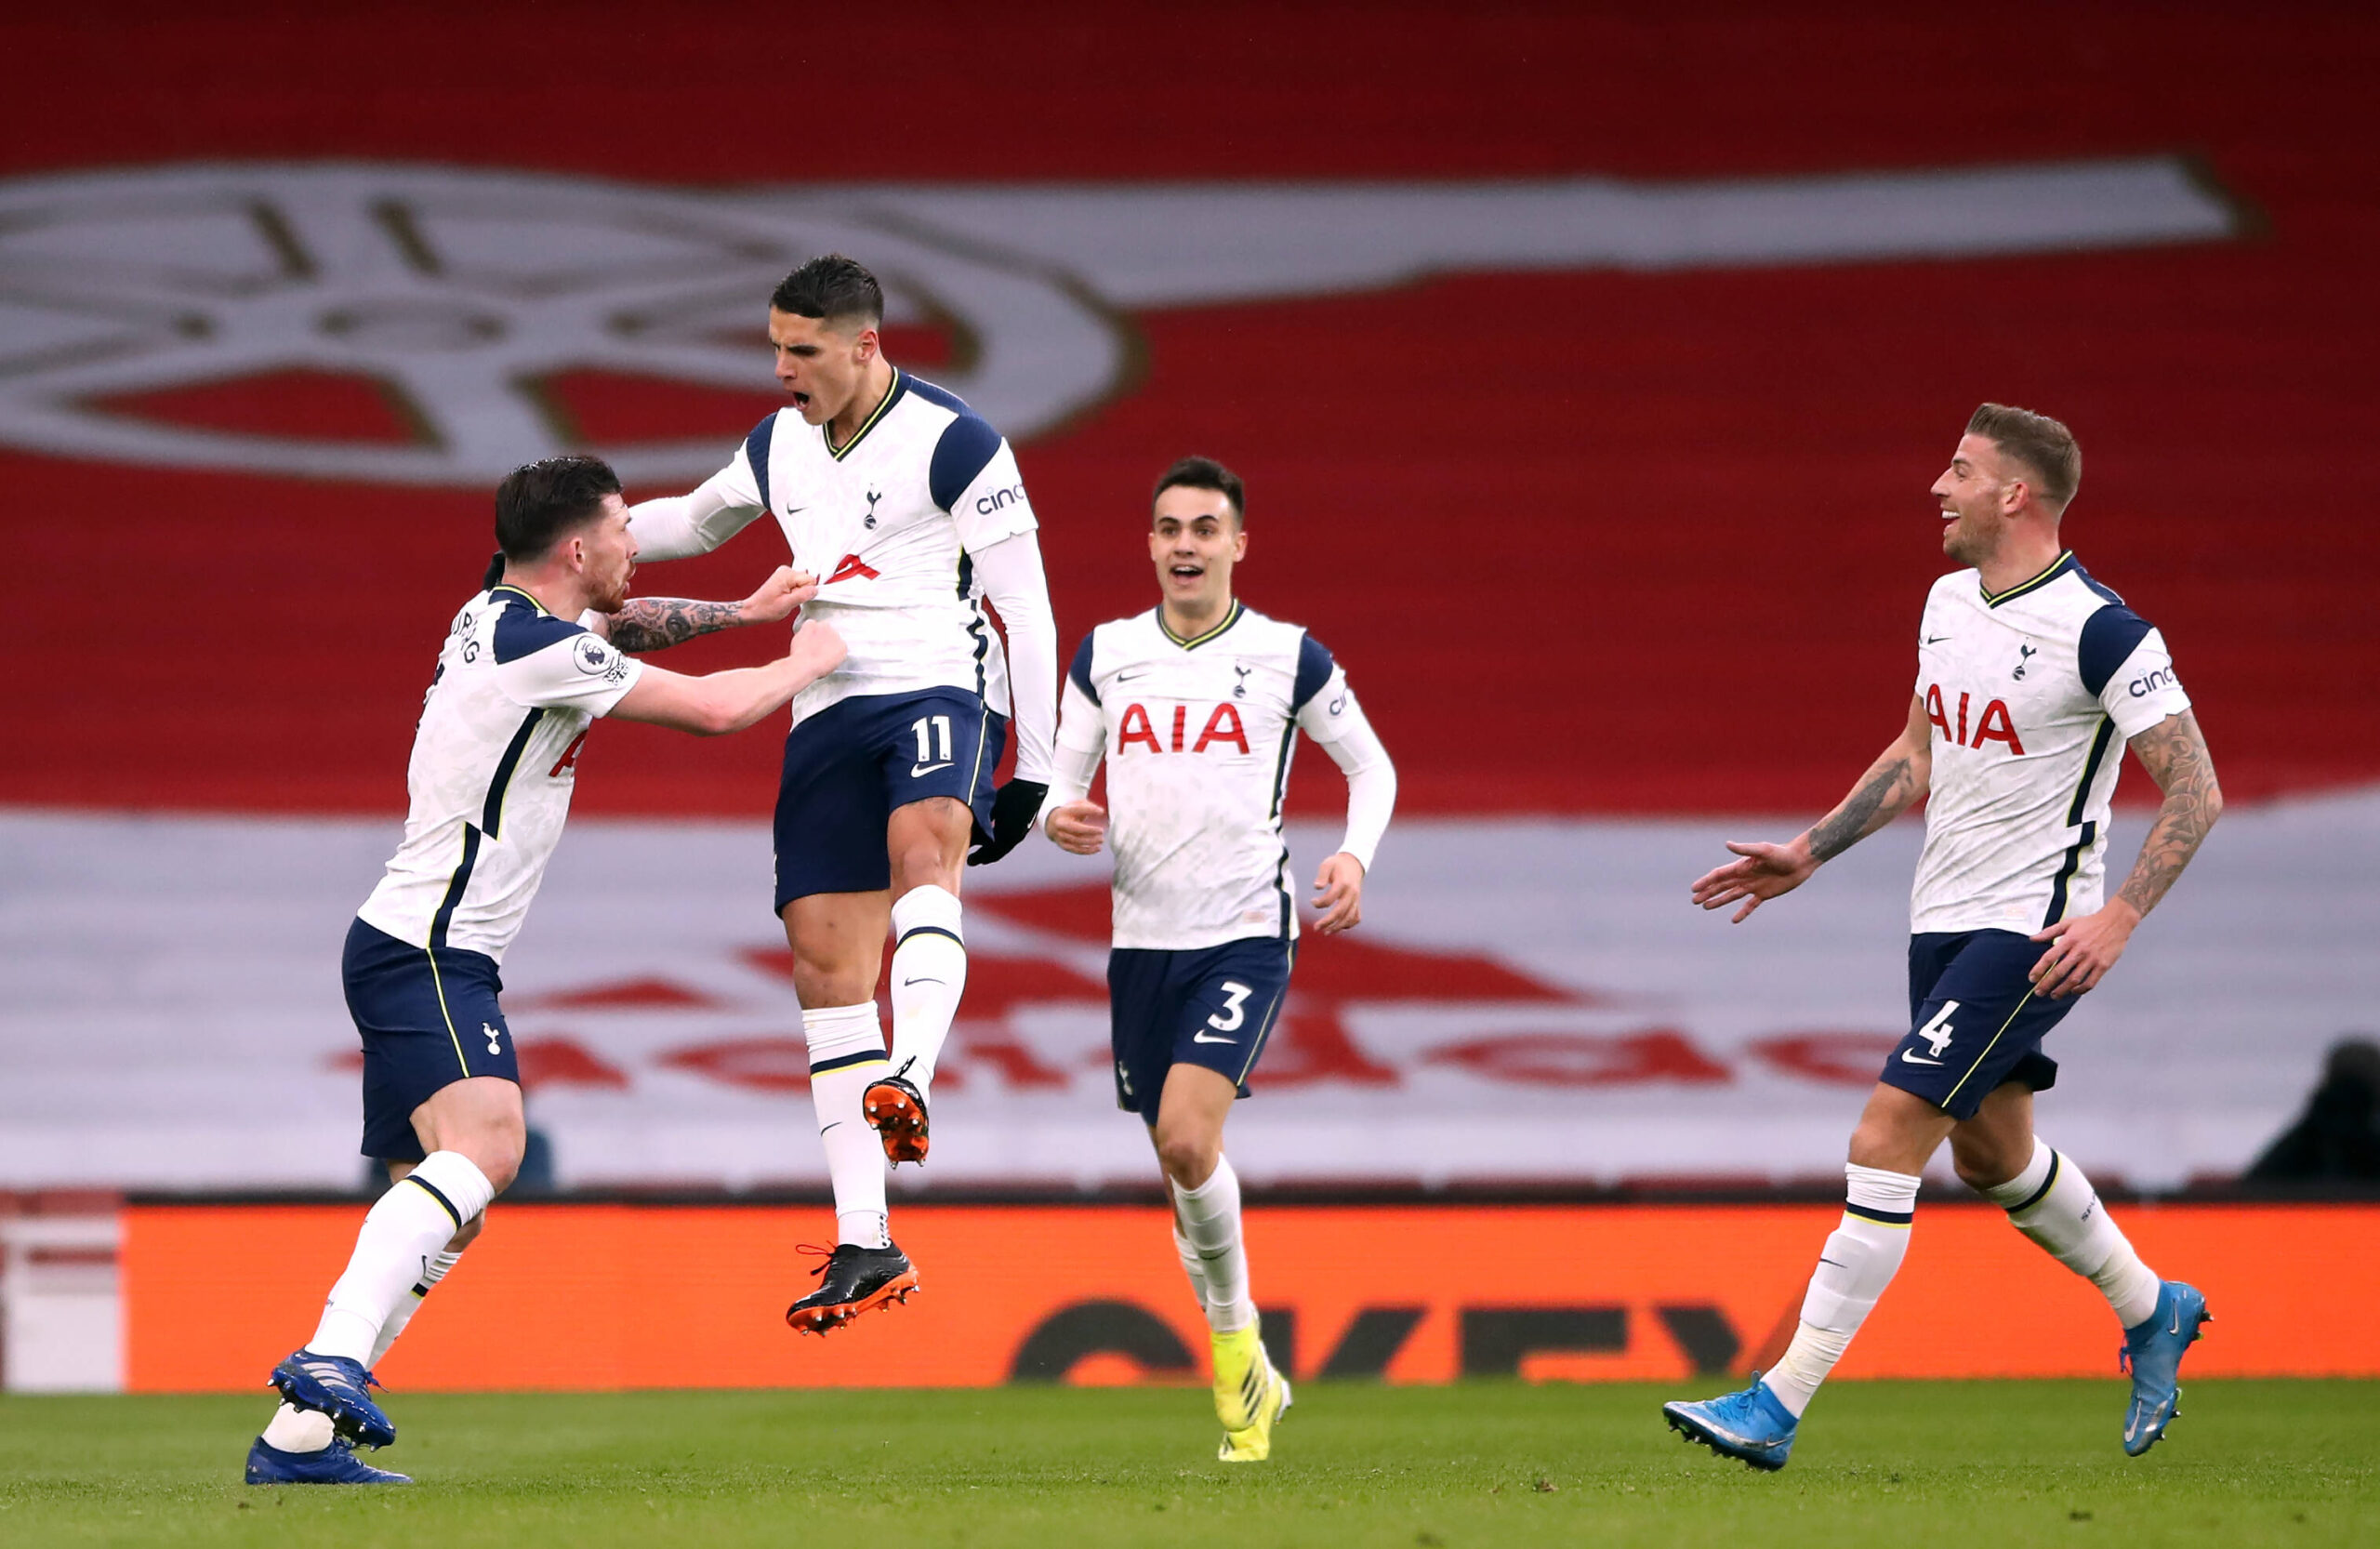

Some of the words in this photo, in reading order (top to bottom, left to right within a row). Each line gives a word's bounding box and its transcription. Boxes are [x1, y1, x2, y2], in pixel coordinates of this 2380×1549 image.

[911, 715, 952, 762] 11
[1117, 703, 1250, 755] AIA
[1926, 683, 2025, 756] AIA
[1207, 981, 1253, 1032] 3
[1918, 1000, 1961, 1058] 4
